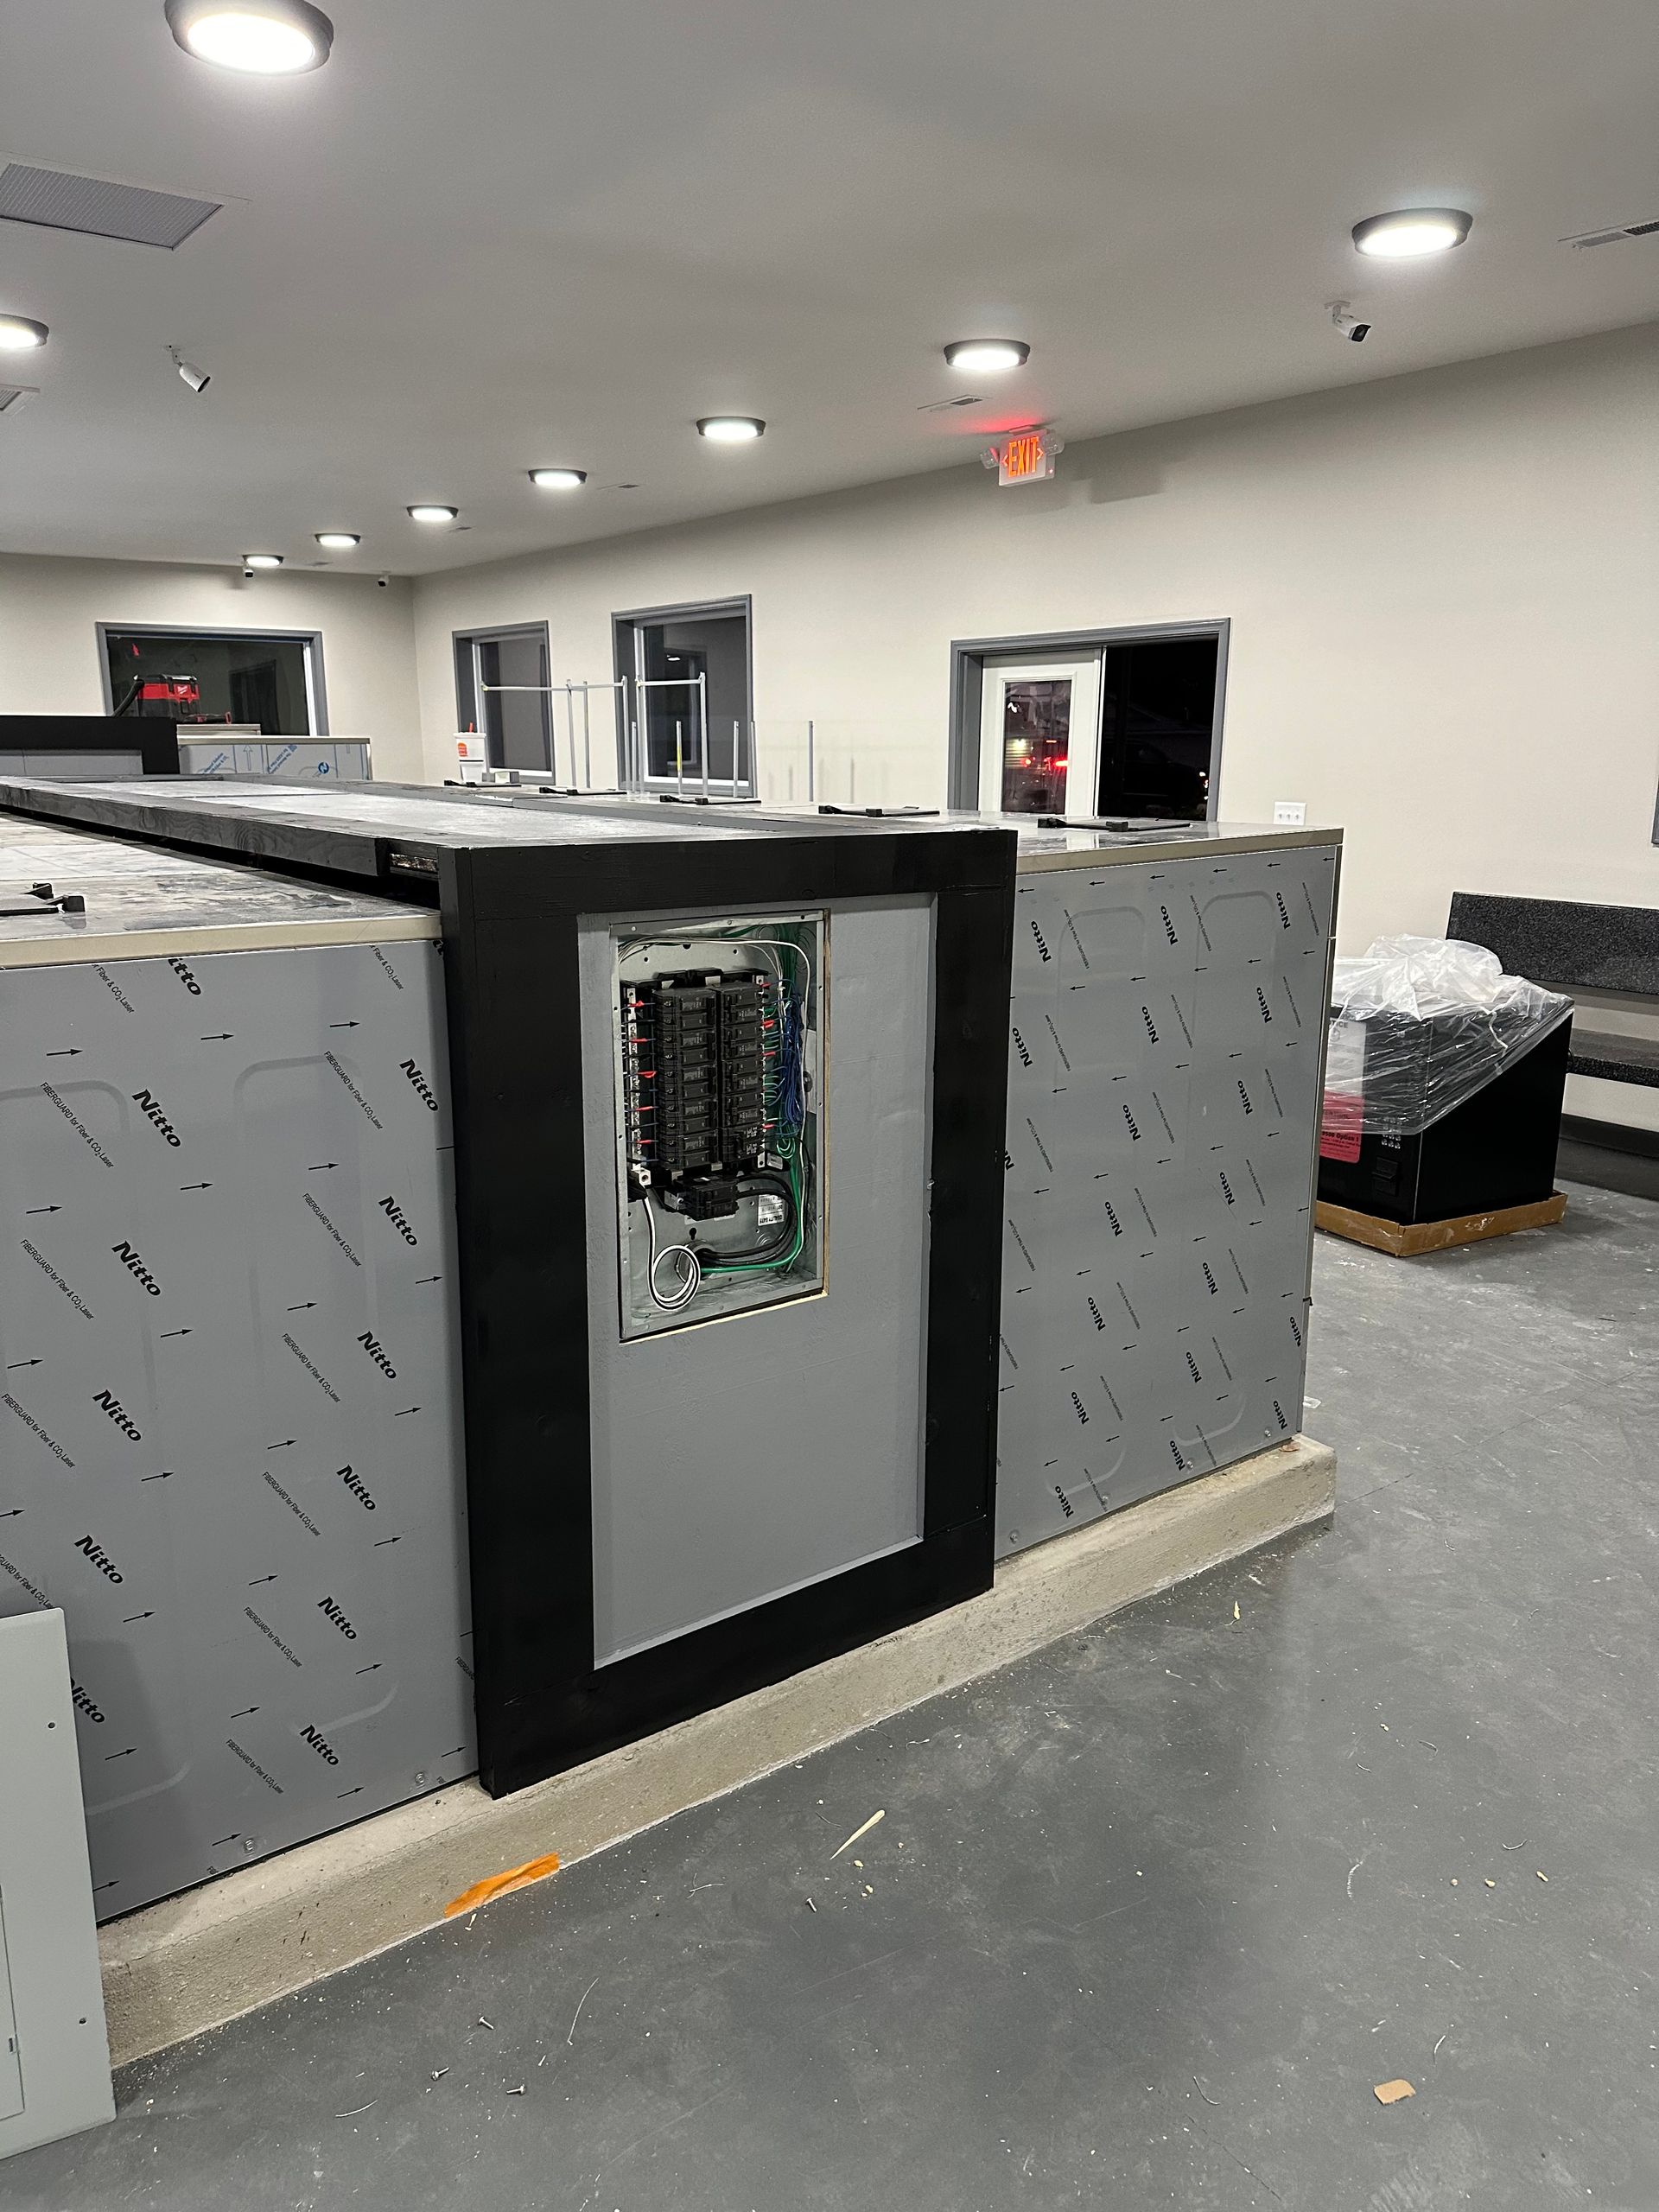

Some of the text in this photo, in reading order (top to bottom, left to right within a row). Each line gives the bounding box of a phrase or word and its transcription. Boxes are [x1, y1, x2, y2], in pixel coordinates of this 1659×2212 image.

[1008, 436, 1039, 478] EXIT
[1161, 906, 1178, 945] Nitto
[1276, 893, 1290, 929] Nitto
[1032, 921, 1052, 963] Nitto
[168, 957, 201, 995] itto
[120, 996, 135, 1014] Laser
[1257, 988, 1272, 1023] Nitto
[1142, 1007, 1159, 1044] Nitto
[1013, 1027, 1033, 1067] Nitto
[324, 1052, 350, 1084] FIBERGUARD
[399, 1058, 438, 1111] Nitto
[1238, 1081, 1253, 1115] Nitto
[41, 1082, 73, 1118] FIBERGUARD
[69, 1117, 79, 1126] for
[76, 1124, 90, 1139] Fiber
[99, 1153, 113, 1167] Laser
[132, 1089, 181, 1147] Nitto
[1123, 1105, 1141, 1141] Nitto
[1220, 1173, 1235, 1205] Nitto
[302, 1193, 329, 1224] FIBERGUARD
[378, 1196, 417, 1245] Nitto
[1105, 1202, 1122, 1236] Nitto
[21, 1239, 53, 1274] FIBERGUARD
[50, 1272, 59, 1281] for
[55, 1279, 69, 1293] Fiber
[79, 1305, 94, 1319] Laser
[111, 1241, 161, 1295] Nitto
[1203, 1262, 1218, 1294] Nitto
[1088, 1297, 1106, 1331] Nitto
[357, 1331, 397, 1378] Nitto
[1186, 1352, 1202, 1382] Nitto
[92, 1389, 141, 1441] Nitto
[1071, 1392, 1090, 1424] Nitto
[1274, 1401, 1287, 1429] Nitto
[2, 1394, 35, 1426] FIBERGUARD
[37, 1430, 51, 1443] Fiber
[60, 1454, 75, 1468] Laser
[1170, 1440, 1185, 1471] Nitto
[336, 1465, 375, 1510] Nitto
[1055, 1486, 1073, 1518] Nitto
[0, 1556, 17, 1574] GUARD
[74, 1535, 123, 1583] Nitto
[317, 1597, 356, 1639] Nitto
[300, 1725, 339, 1765] Nitto
